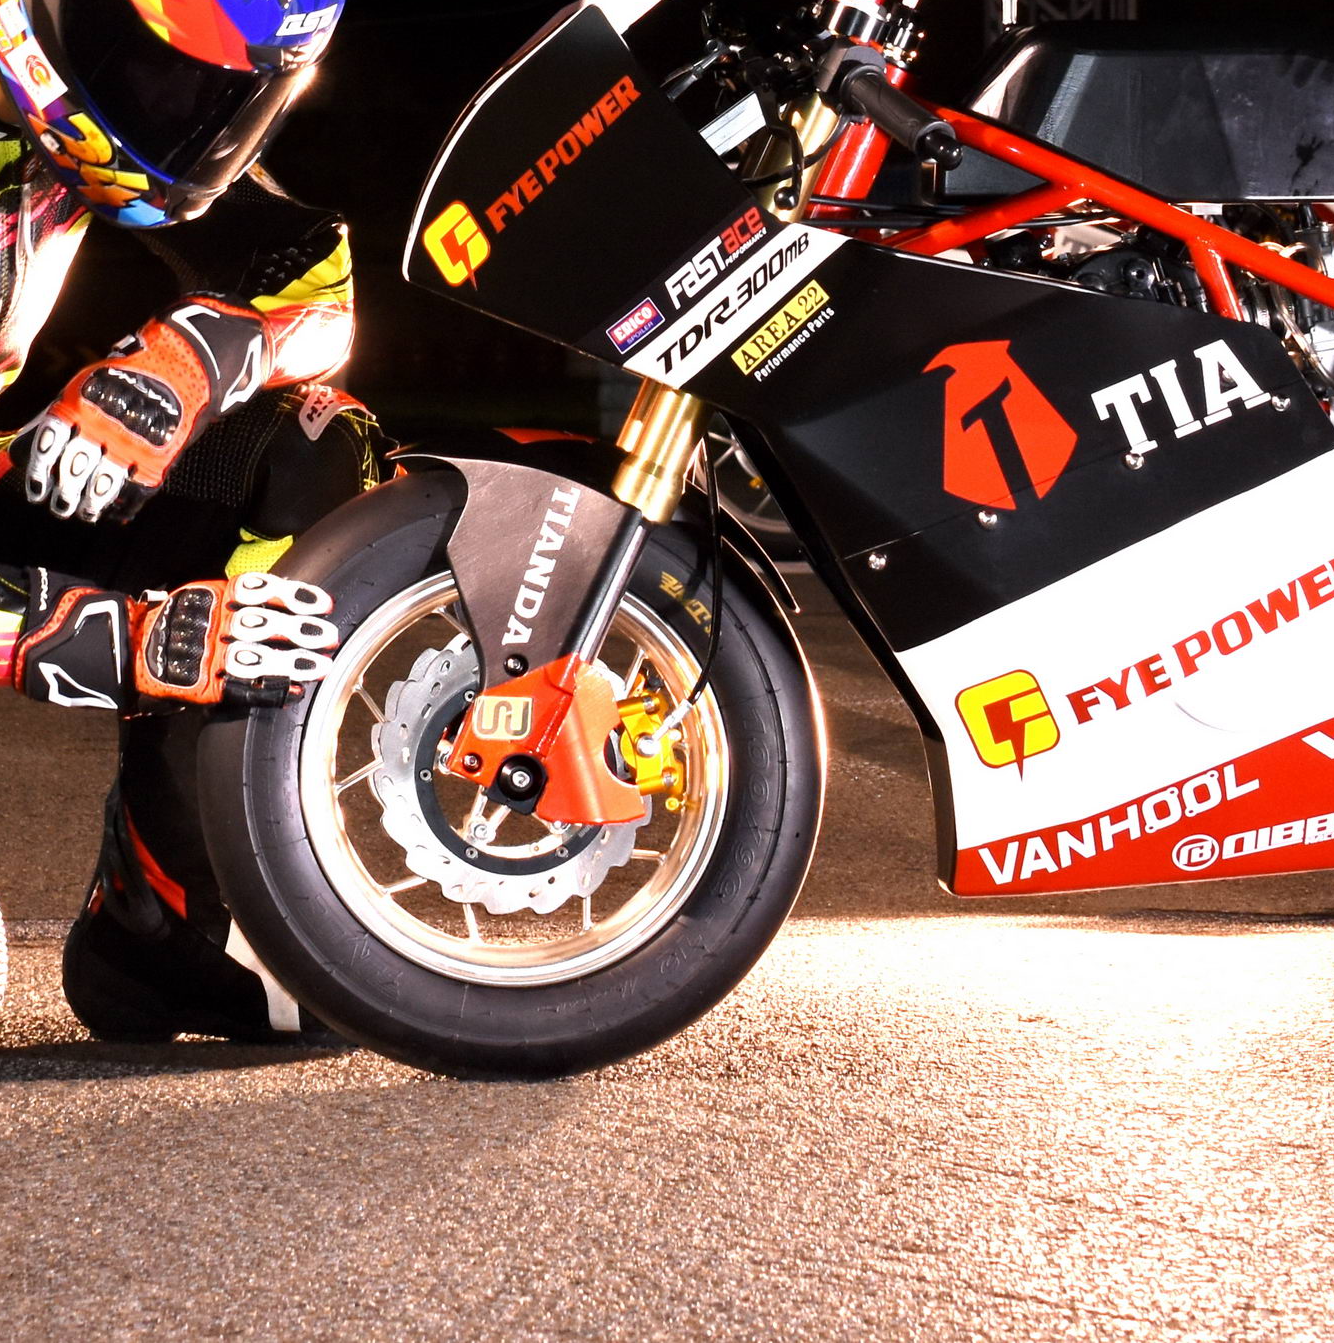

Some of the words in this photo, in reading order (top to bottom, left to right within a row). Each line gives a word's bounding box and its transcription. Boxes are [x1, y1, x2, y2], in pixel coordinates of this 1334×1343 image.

[485, 169, 544, 233] FYE
[535, 75, 642, 184] POWER
[725, 227, 767, 267] PERFORMANCE
[612, 306, 653, 342] ERICO
[626, 321, 654, 345] SPOILER
[741, 311, 802, 371] AREA
[798, 286, 825, 314] 22
[754, 331, 811, 383] Performance
[809, 306, 835, 333] Parts
[1090, 338, 1272, 455] TIA
[501, 487, 581, 646] TIANDA
[1066, 654, 1171, 724] FYE
[978, 764, 1260, 886] VANHOOL
